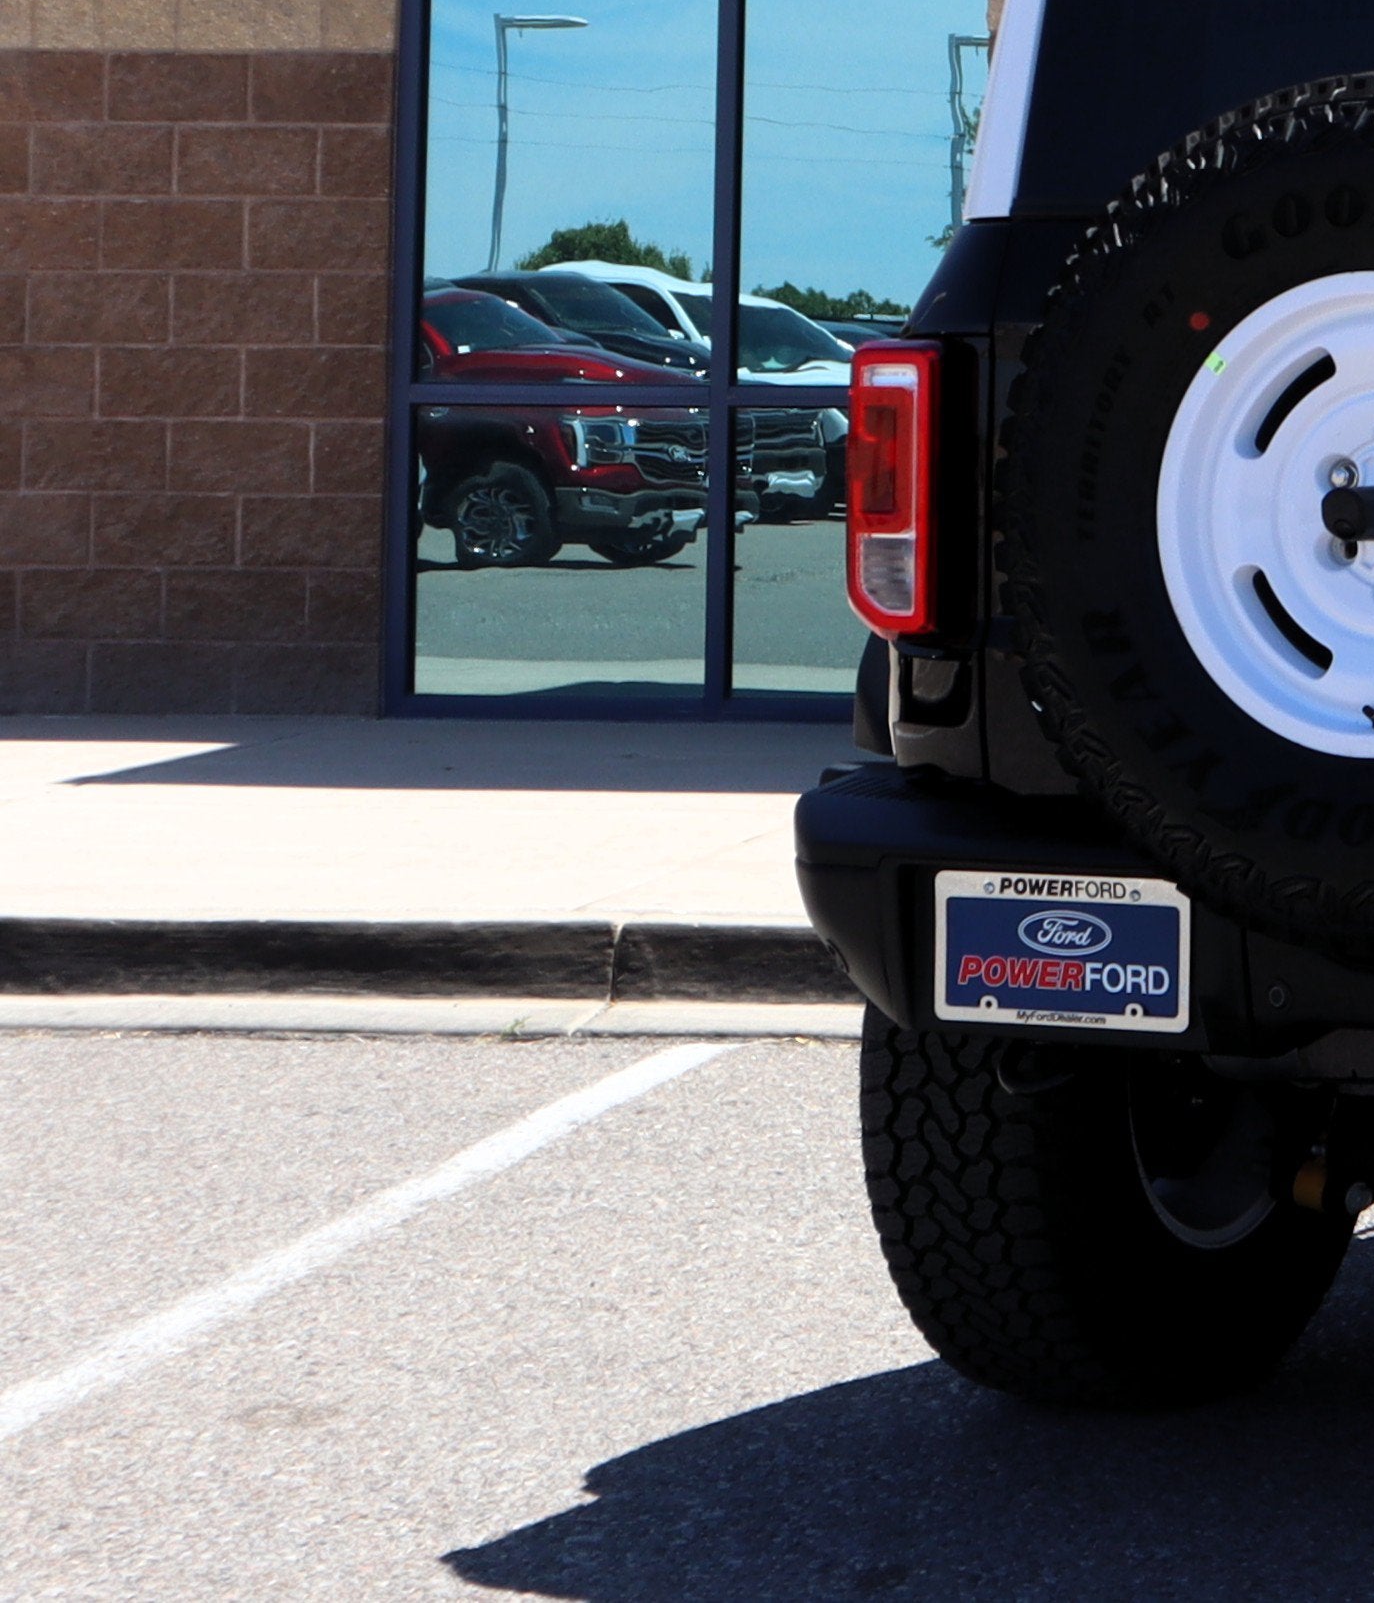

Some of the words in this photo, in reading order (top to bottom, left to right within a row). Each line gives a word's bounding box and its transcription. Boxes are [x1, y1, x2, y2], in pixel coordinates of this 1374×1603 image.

[998, 876, 1127, 900] POWERFORD
[1036, 916, 1092, 947] Ford
[957, 954, 1171, 997] POWERFORD
